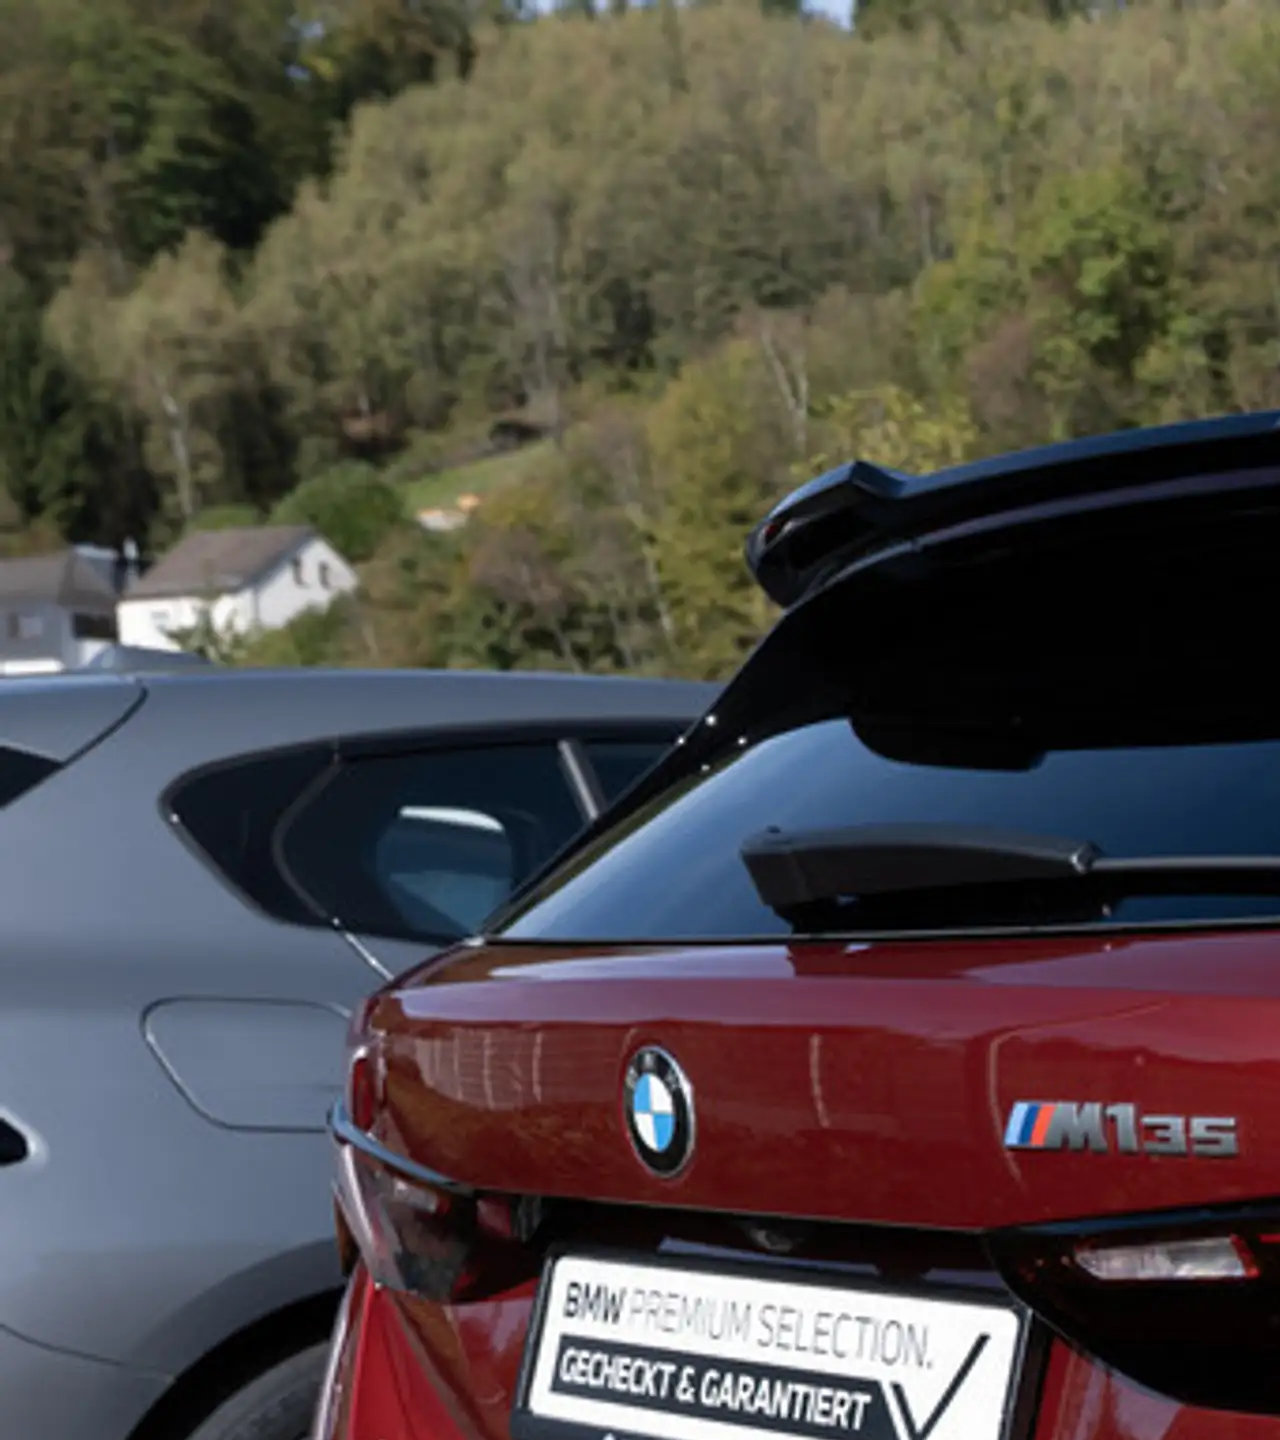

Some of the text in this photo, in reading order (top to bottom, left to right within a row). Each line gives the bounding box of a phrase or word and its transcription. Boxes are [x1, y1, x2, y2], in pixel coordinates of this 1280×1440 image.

[1044, 1102, 1239, 1156] M135
[563, 1281, 932, 1369] BMW PREMIUM SELECTION.
[559, 1347, 873, 1431] GECHECKT & GARANTIERT
